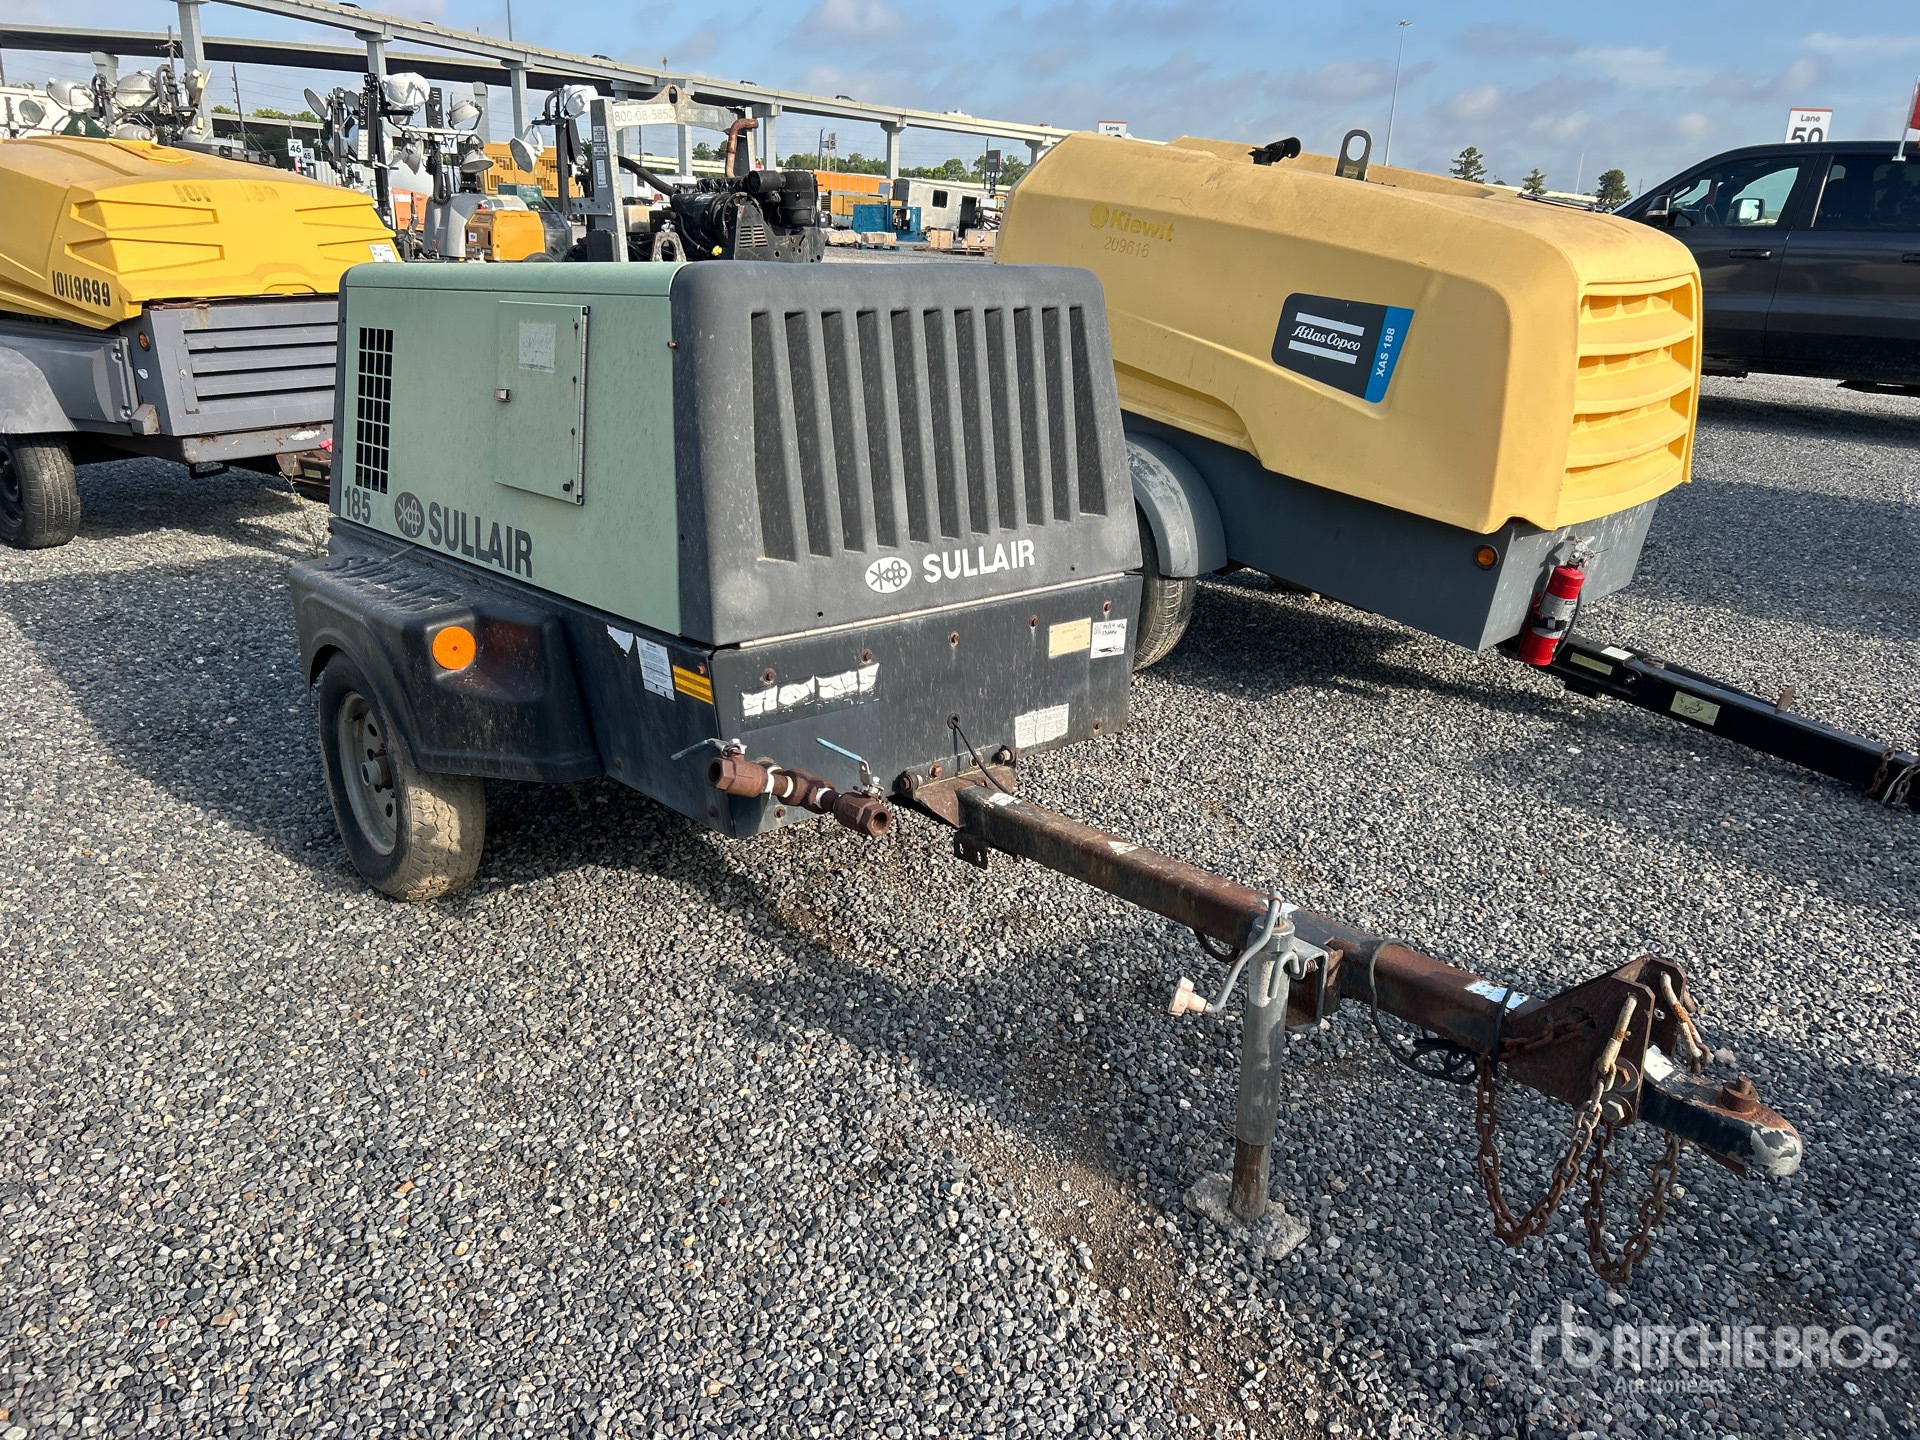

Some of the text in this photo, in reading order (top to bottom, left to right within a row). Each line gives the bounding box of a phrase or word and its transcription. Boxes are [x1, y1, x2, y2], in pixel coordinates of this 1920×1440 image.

[1790, 126, 1824, 143] 50
[1800, 114, 1821, 122] Lane
[290, 145, 301, 153] 46
[1109, 208, 1176, 242] Kiewit
[1104, 235, 1150, 258] 209616
[52, 270, 111, 307] 10119699
[1291, 325, 1361, 351] Atlas Copco
[1376, 327, 1396, 378] XAS 188
[344, 485, 372, 525] 185
[428, 501, 533, 579] SULLAIR
[922, 539, 1036, 584] SULLAIR
